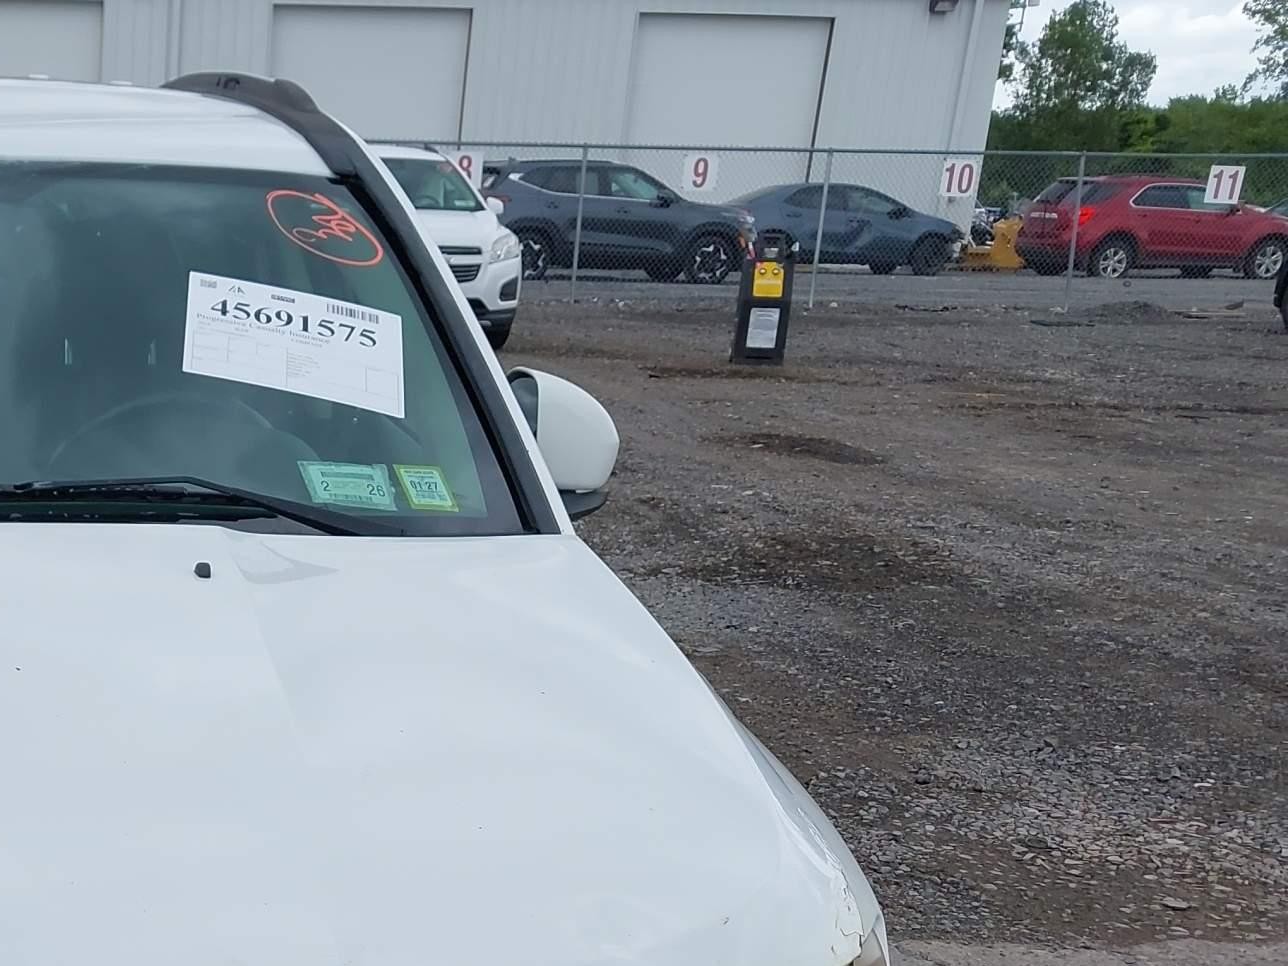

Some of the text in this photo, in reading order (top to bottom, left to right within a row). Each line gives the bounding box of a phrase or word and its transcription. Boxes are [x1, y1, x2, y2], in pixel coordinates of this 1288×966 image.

[692, 157, 709, 188] 9
[945, 163, 974, 194] 10
[1213, 169, 1240, 200] 11
[210, 298, 377, 348] 45691575
[320, 480, 331, 492] 2
[366, 483, 386, 497] 26
